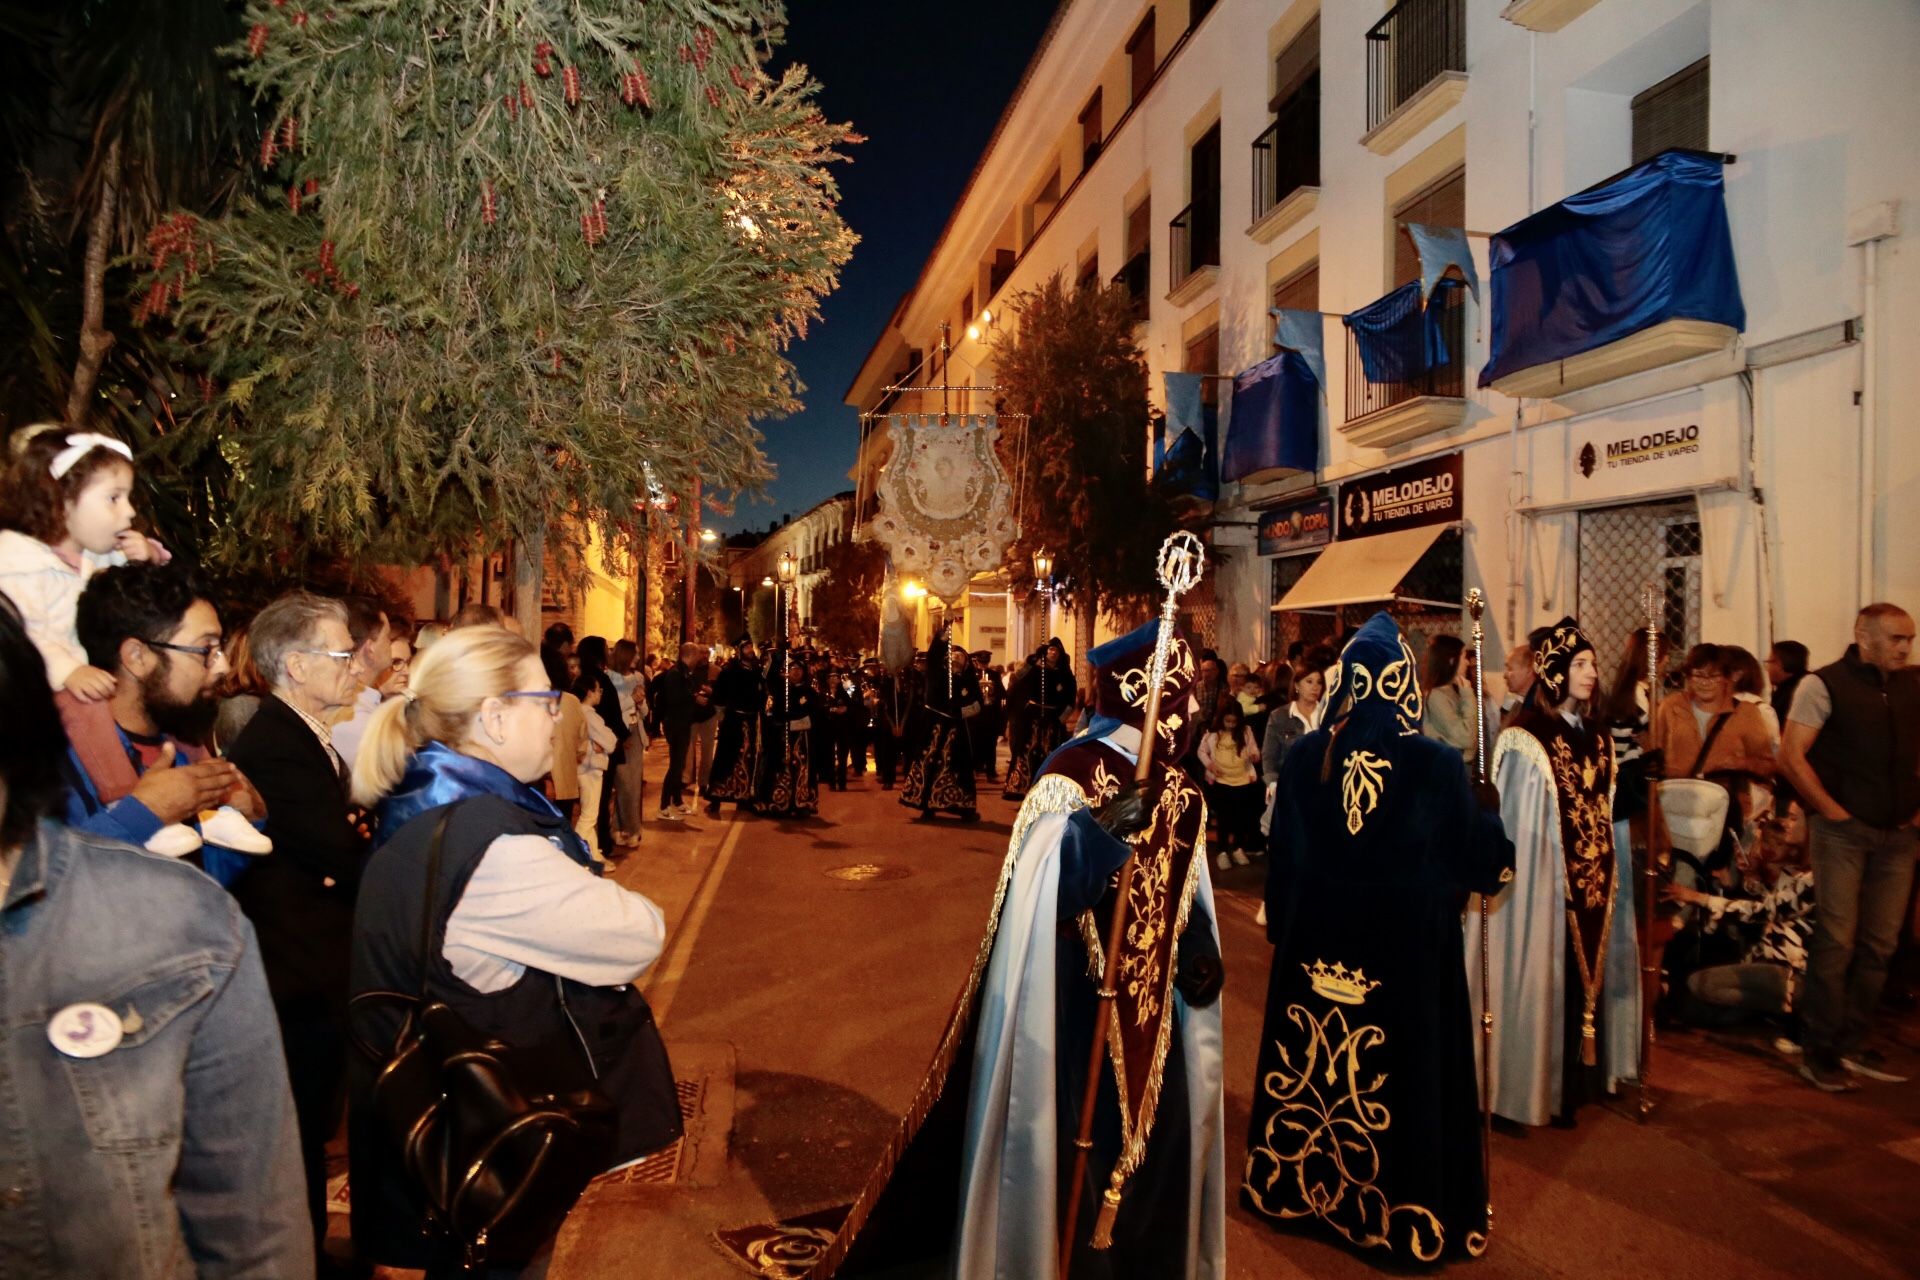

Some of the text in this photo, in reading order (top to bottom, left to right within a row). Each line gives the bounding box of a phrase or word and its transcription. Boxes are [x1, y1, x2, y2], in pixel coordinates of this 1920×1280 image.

[1607, 424, 1699, 457] MELODEJO
[1607, 444, 1699, 469] TU TIENDA DE VAPEO
[1372, 472, 1454, 507] MELODEJO
[1373, 497, 1453, 522] TU TIENDA DE VAPEO
[1264, 520, 1290, 538] NDO
